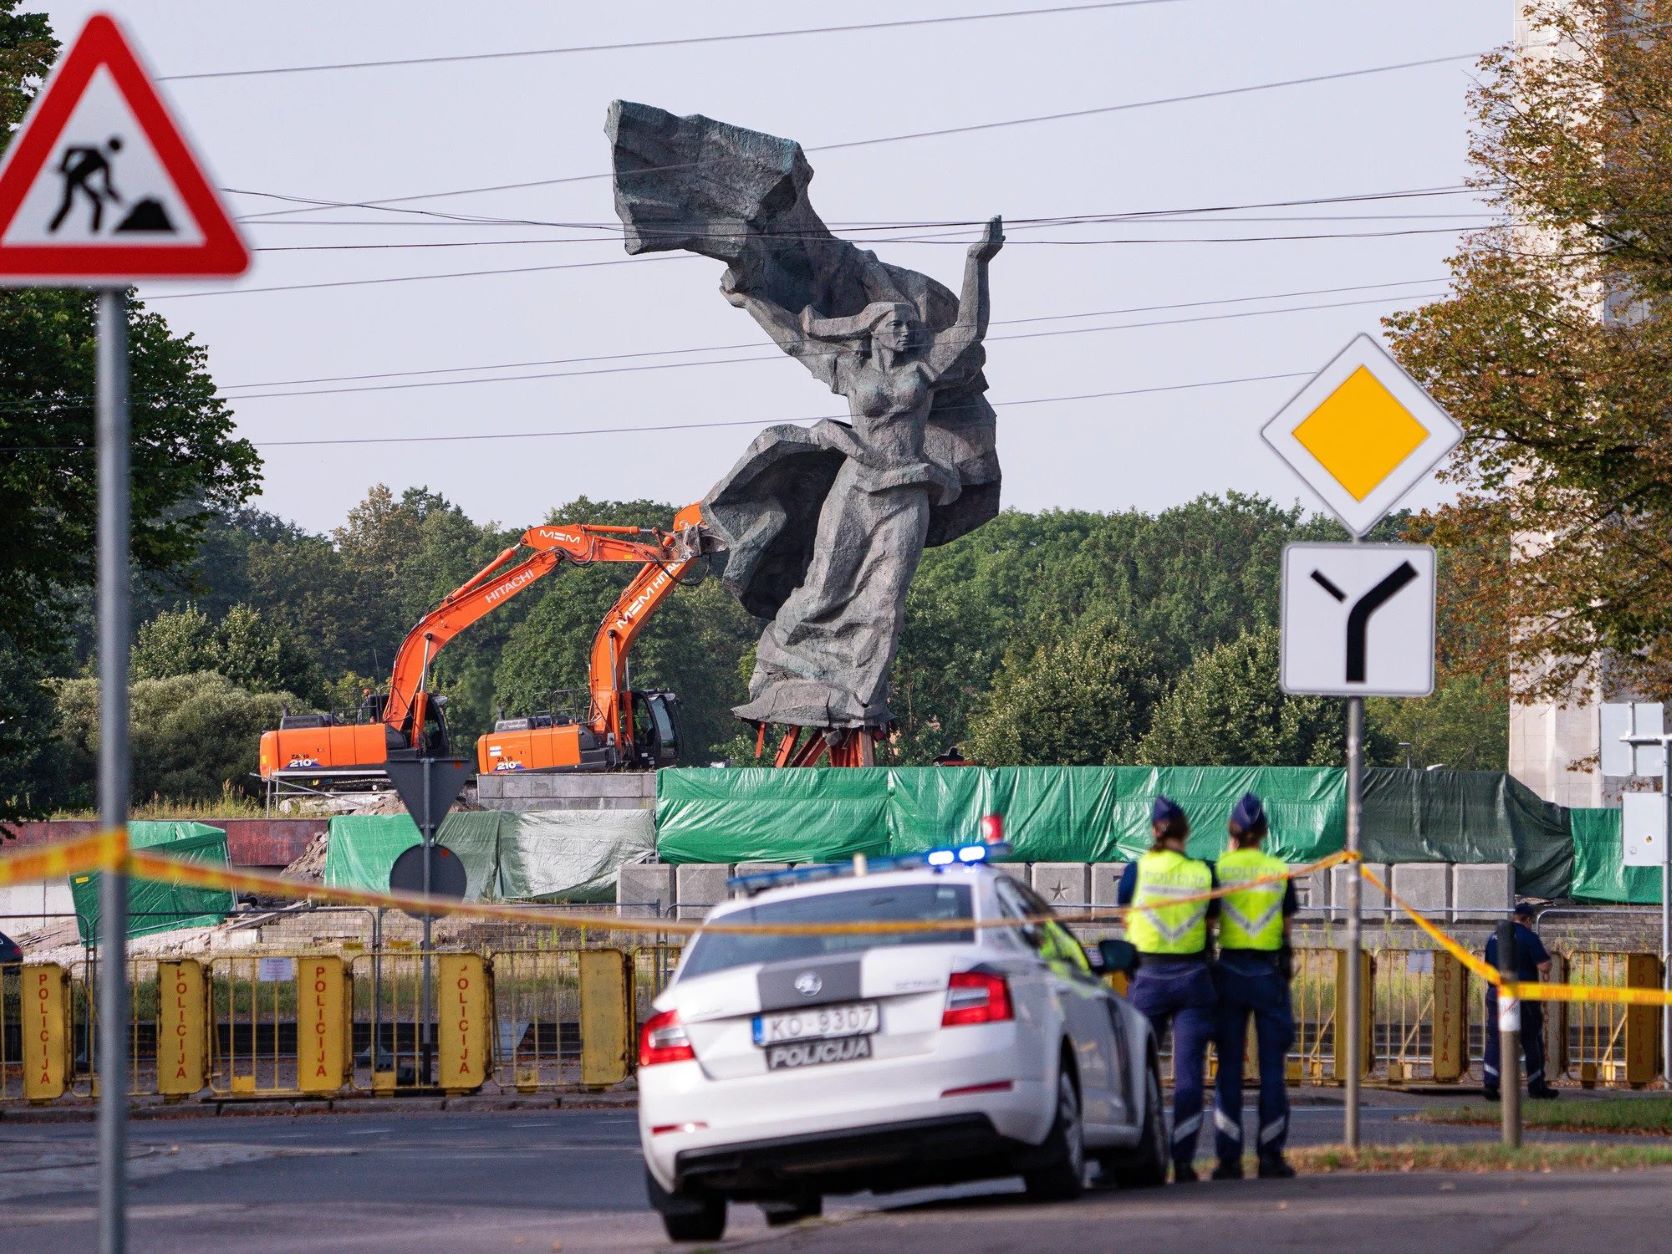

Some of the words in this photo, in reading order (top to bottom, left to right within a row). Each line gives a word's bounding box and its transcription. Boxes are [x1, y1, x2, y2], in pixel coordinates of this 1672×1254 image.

[485, 569, 535, 603] HITACHI
[38, 974, 50, 1084] POLICIJA
[315, 966, 327, 1077] POLICIJA
[457, 965, 470, 1074] OLICIJA
[771, 1037, 869, 1070] POLICIJA
